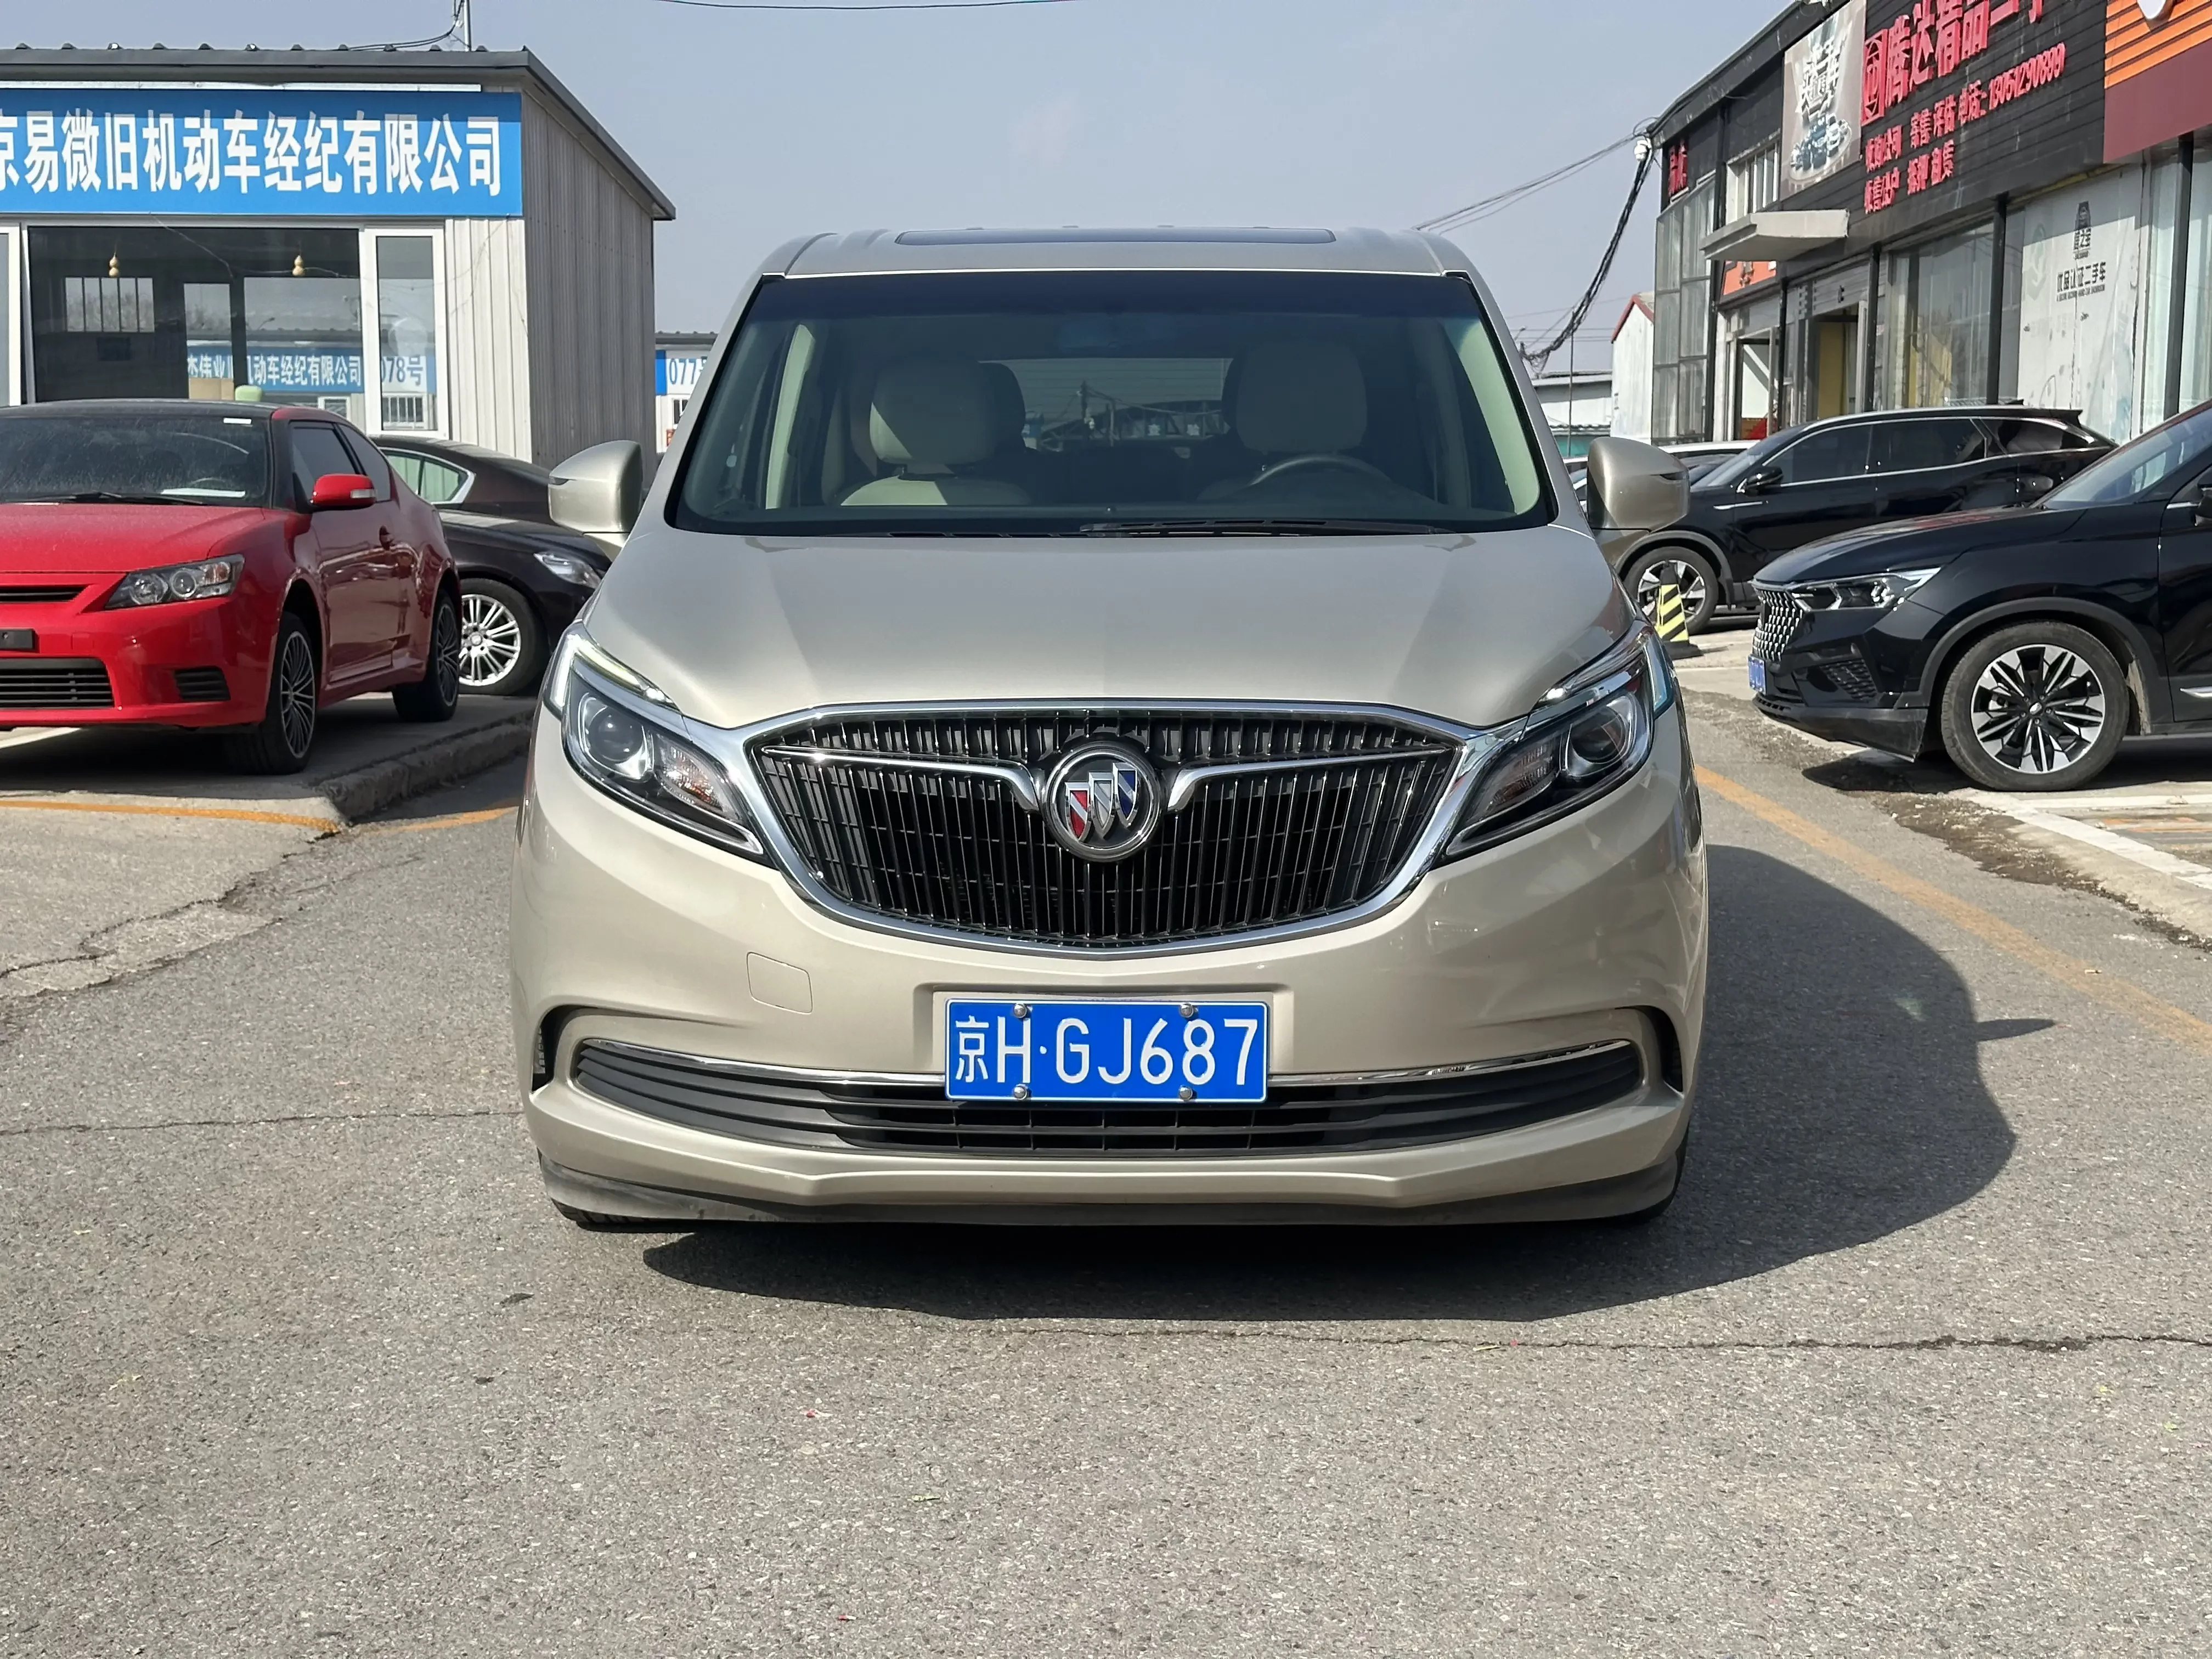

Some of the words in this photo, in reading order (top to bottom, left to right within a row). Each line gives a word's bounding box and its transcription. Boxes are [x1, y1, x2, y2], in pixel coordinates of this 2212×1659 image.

[1885, 0, 2042, 108] 腾达精品
[0, 107, 501, 197] 京易微旧机动车经纪有限公司
[955, 1014, 1259, 1086] 京H·GJ687
